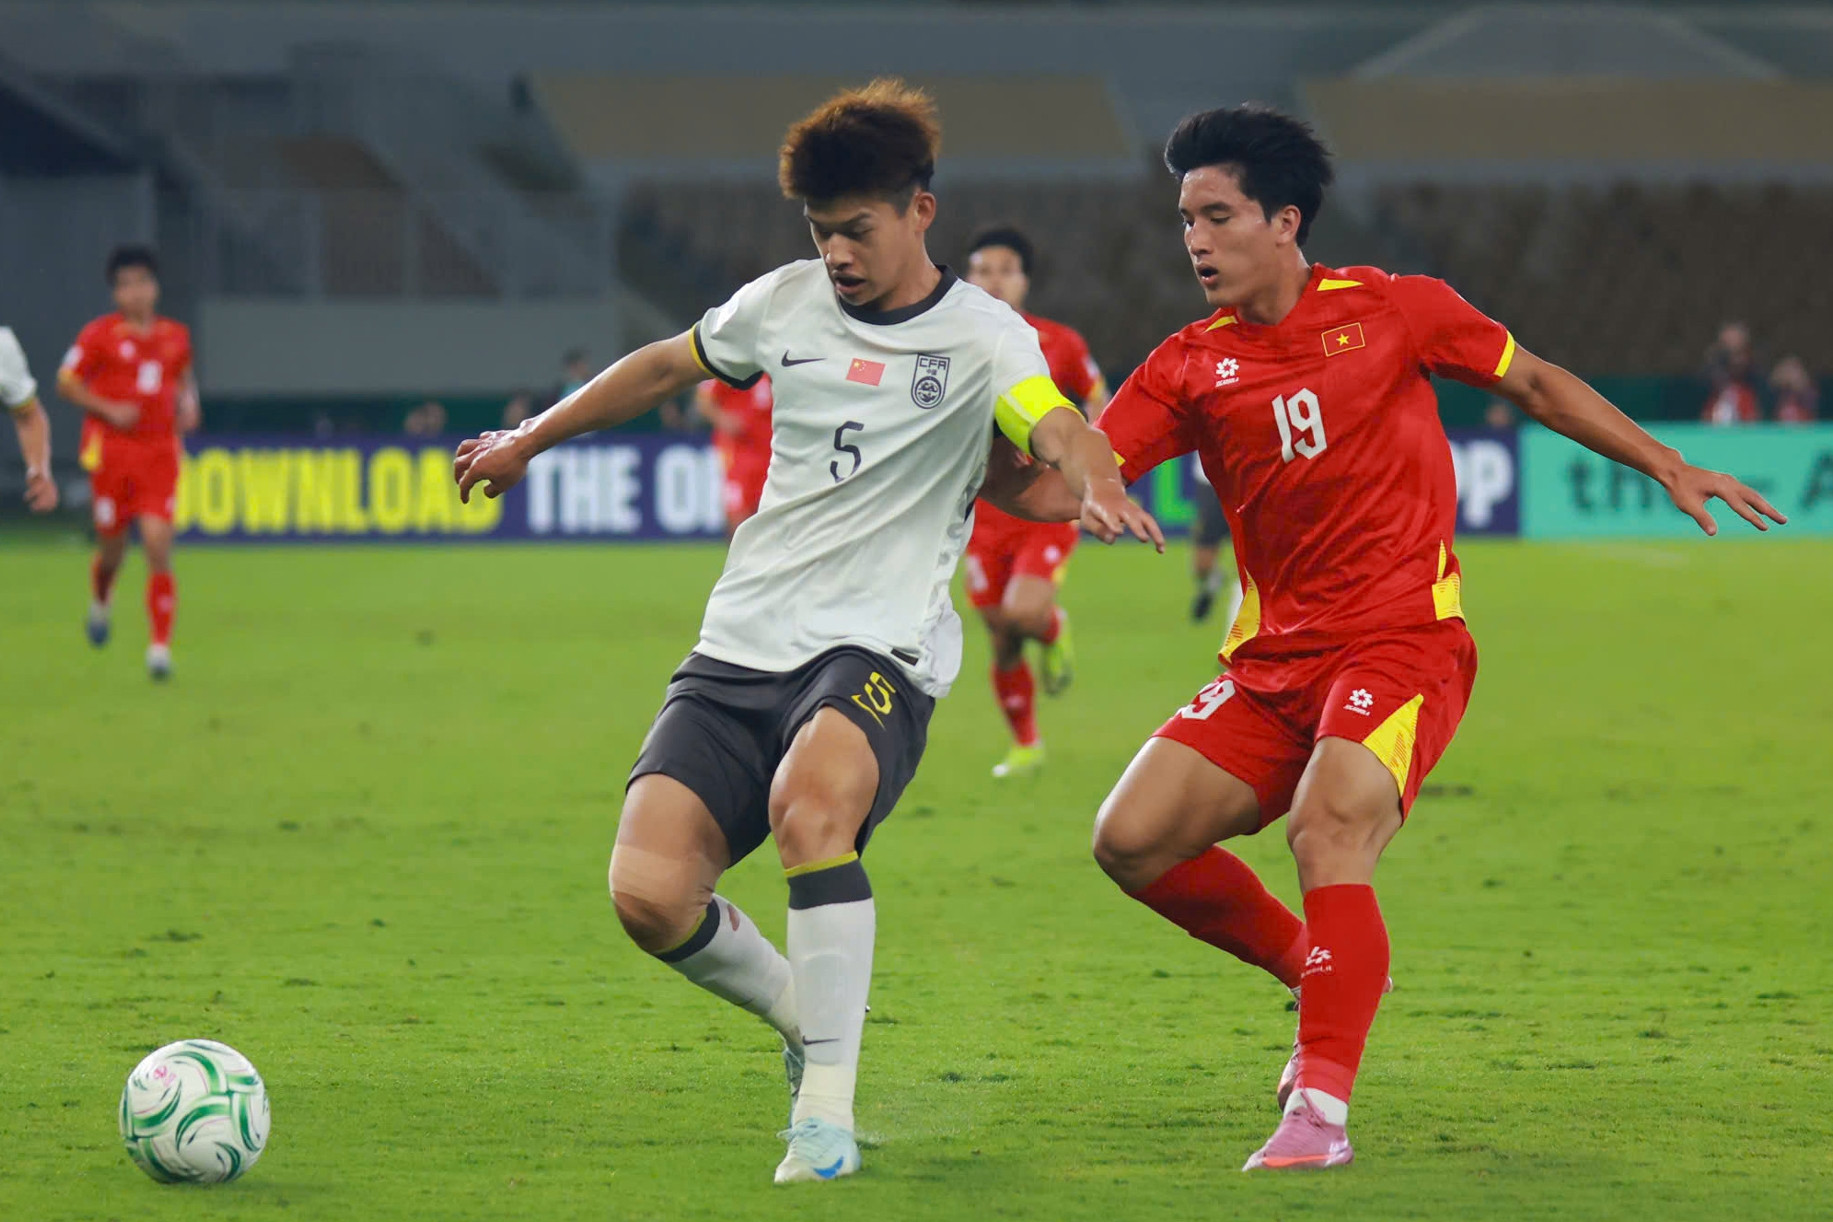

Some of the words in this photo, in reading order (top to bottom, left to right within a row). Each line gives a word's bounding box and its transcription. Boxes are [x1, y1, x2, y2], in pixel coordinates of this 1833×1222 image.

[919, 357, 947, 371] CFA
[829, 420, 865, 483] 5
[1271, 387, 1328, 464] 19
[527, 445, 642, 533] THE
[863, 671, 896, 715] 5
